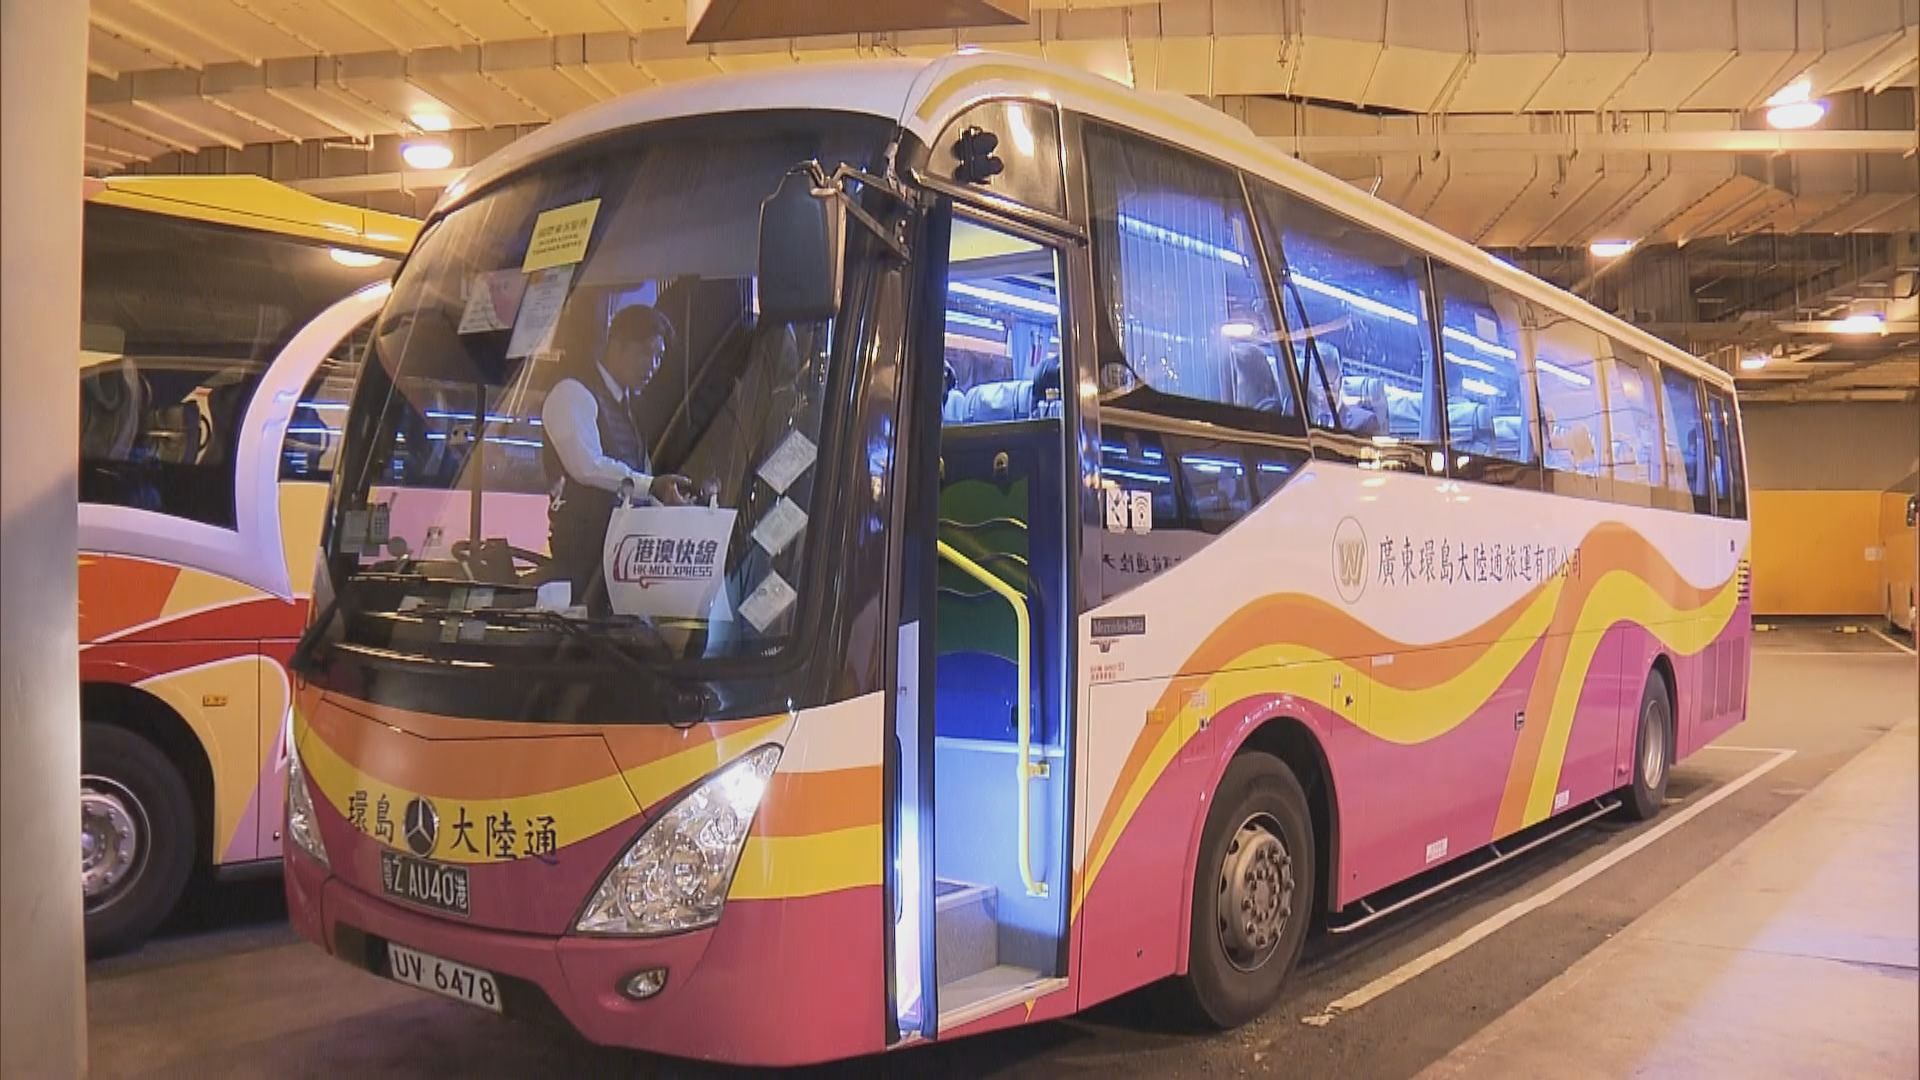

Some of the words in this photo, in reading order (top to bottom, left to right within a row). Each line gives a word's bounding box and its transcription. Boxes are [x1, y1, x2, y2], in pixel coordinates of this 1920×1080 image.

[634, 538, 718, 564] 港澳快線
[1377, 537, 1582, 586] 廣東環島大陸通旅運有限公司
[348, 790, 394, 843] 環島
[450, 806, 560, 866] 大陸通
[393, 950, 422, 983] UV
[434, 962, 496, 1006] 6478
